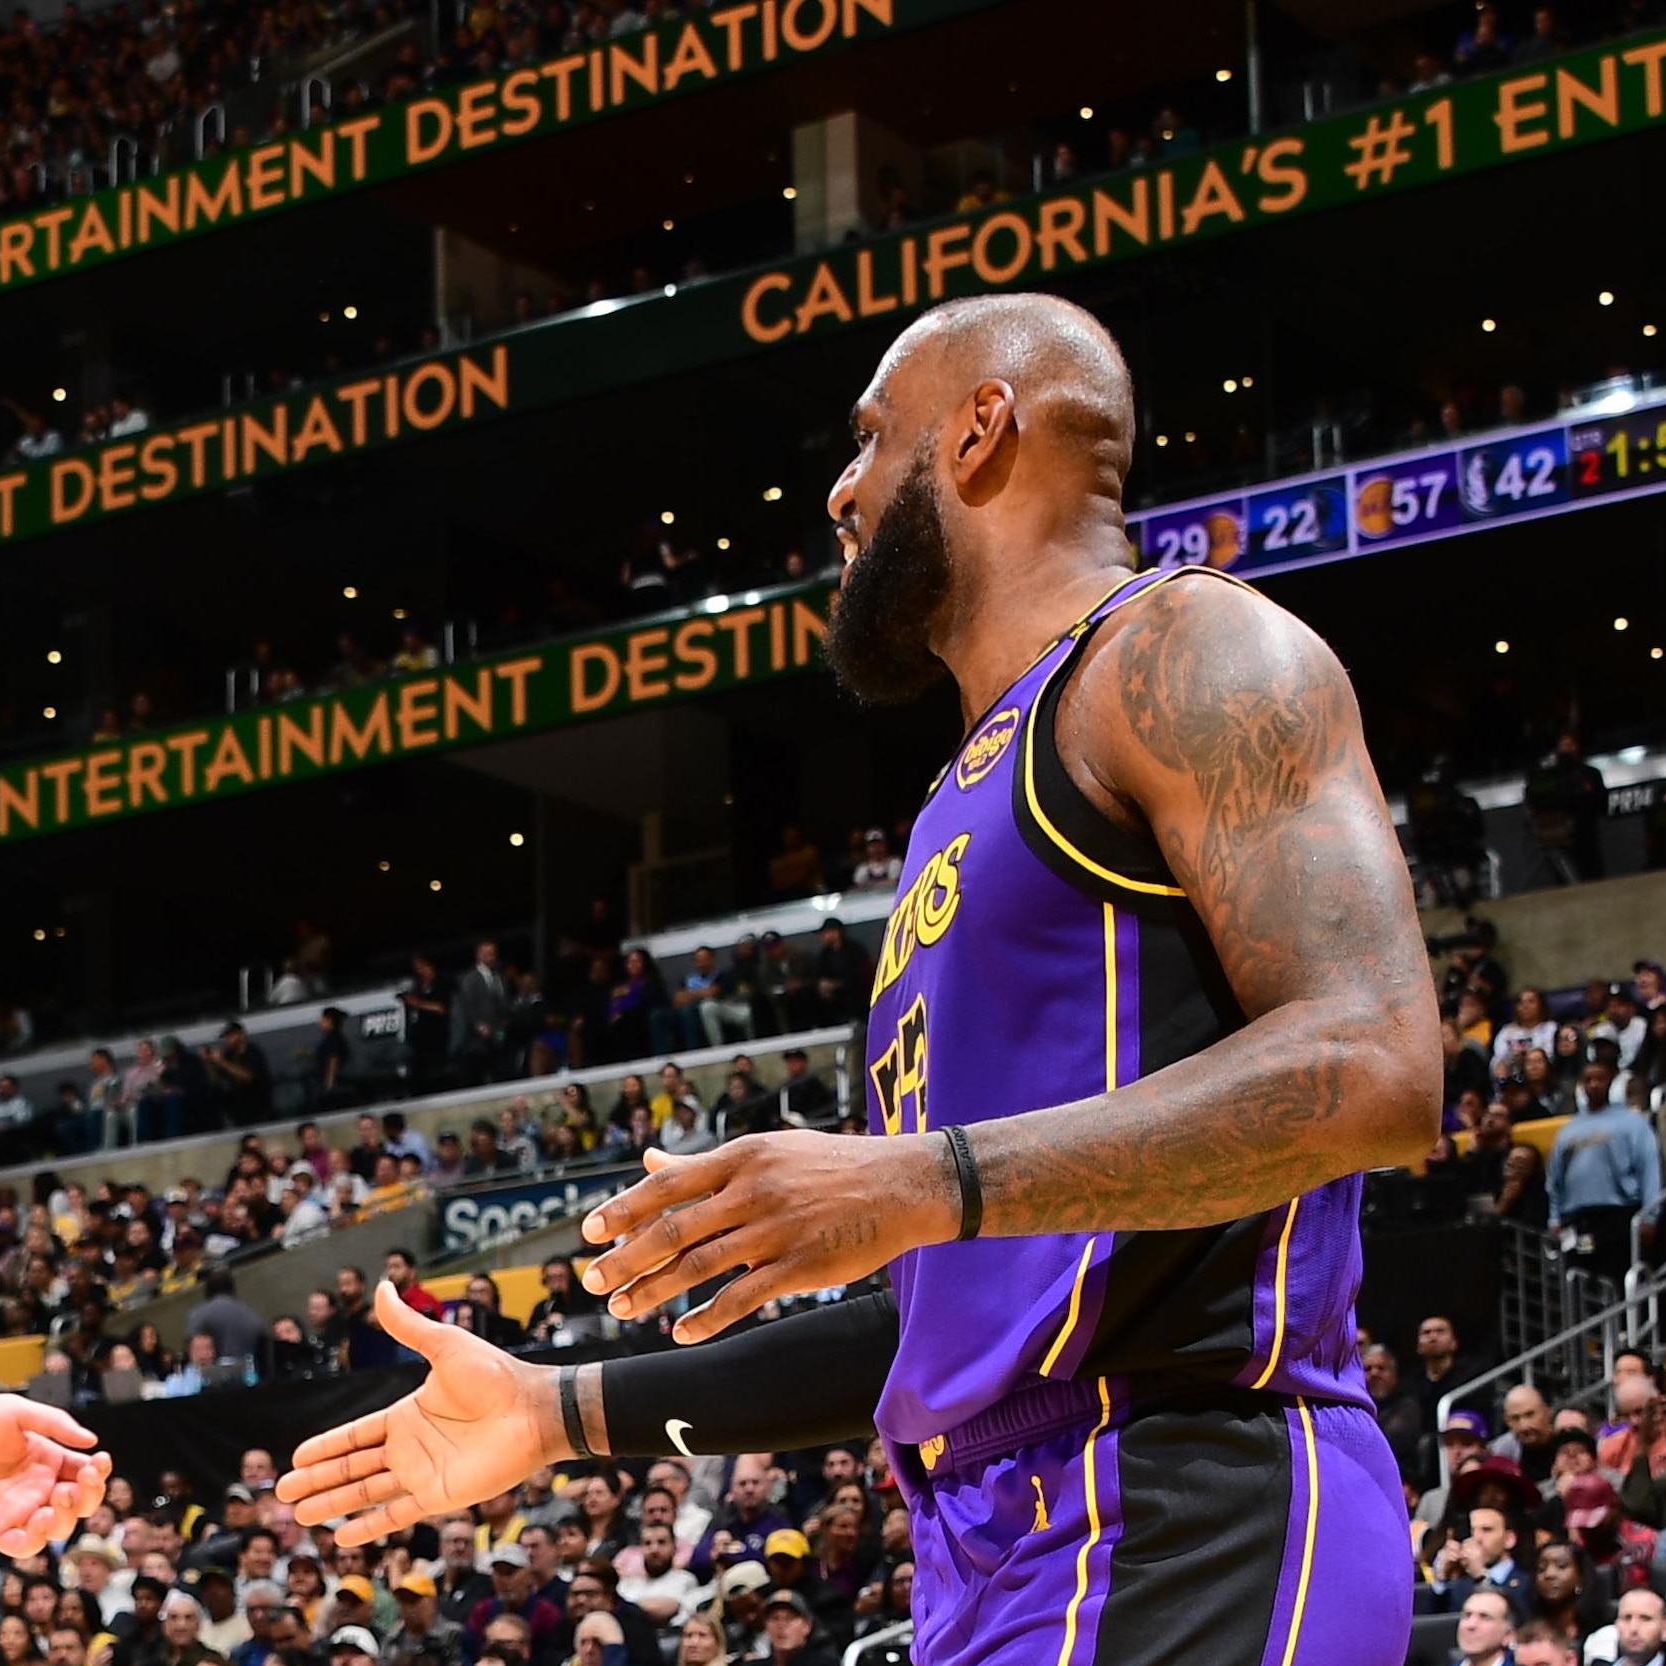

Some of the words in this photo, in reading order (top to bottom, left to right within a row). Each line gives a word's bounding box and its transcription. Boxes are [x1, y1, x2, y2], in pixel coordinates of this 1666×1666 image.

[406, 0, 893, 164] DESTINATION
[742, 138, 1307, 342] CALIFORNIA'S
[1345, 98, 1454, 189] #1
[51, 346, 508, 523] DESTINATION
[1156, 522, 1210, 569] 29
[1263, 498, 1321, 552] 22
[1391, 471, 1449, 527] 57
[1494, 448, 1558, 502] 42
[1579, 447, 1602, 485] 2
